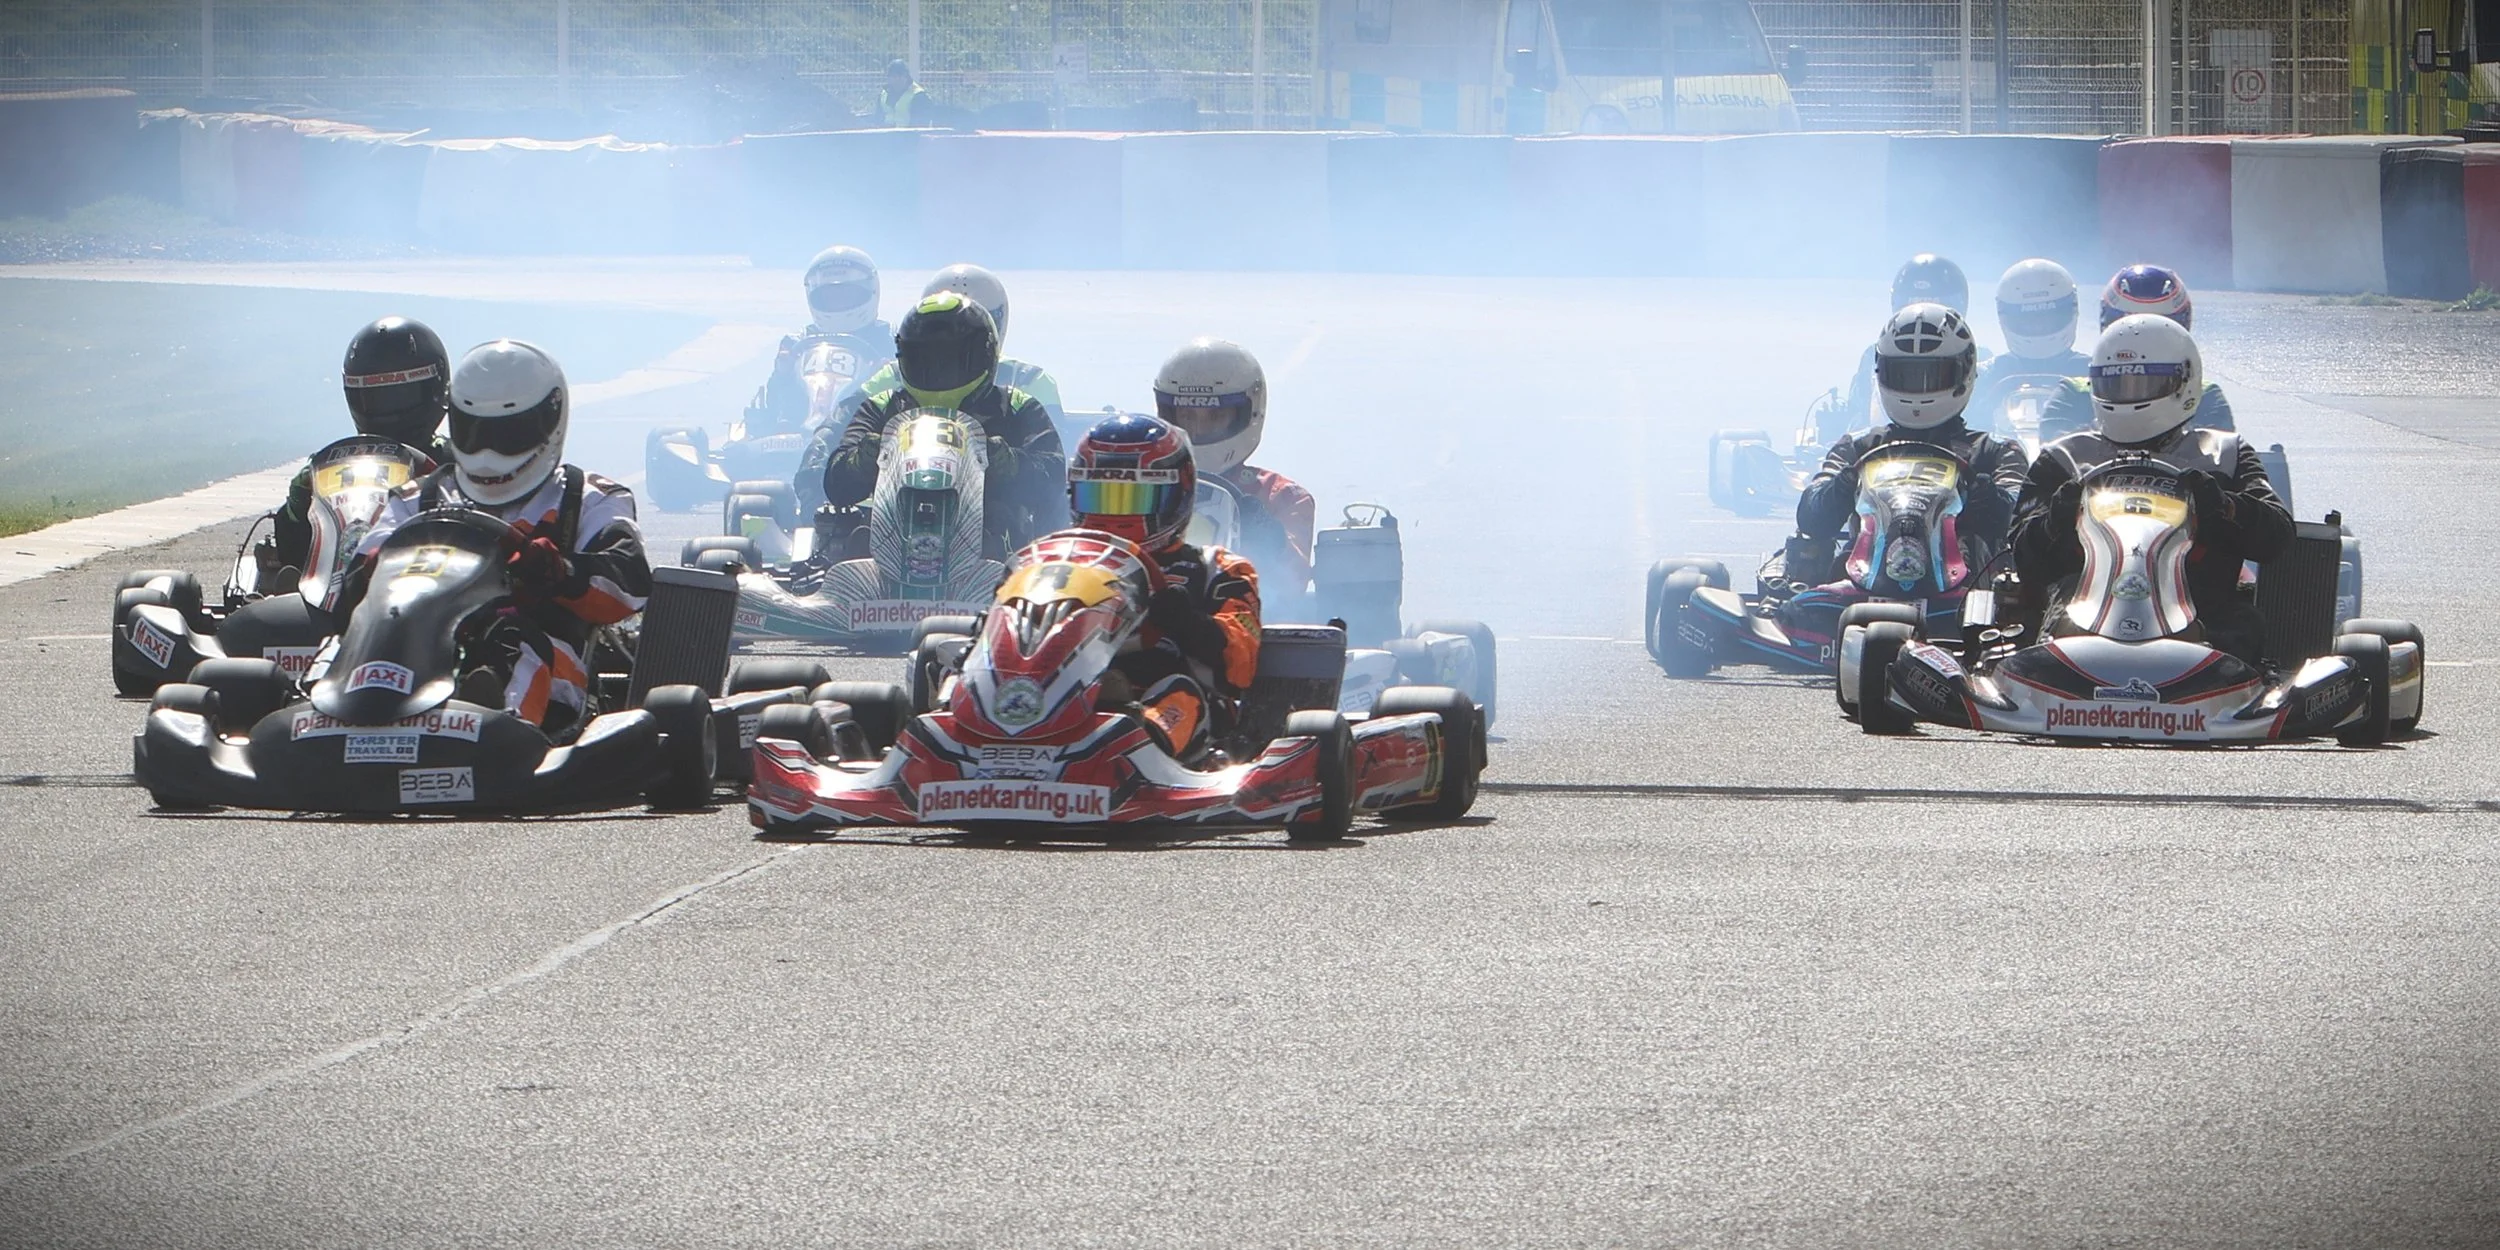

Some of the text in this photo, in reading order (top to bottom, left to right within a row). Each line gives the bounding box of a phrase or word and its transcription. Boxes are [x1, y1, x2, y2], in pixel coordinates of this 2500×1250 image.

[2237, 75, 2260, 91] 10
[803, 351, 856, 377] 43
[2102, 364, 2146, 377] NKRA
[1173, 396, 1220, 406] NKRA
[1087, 469, 1136, 481] NKRA
[2124, 497, 2153, 514] 6
[851, 601, 970, 625] planetkarting
[2046, 703, 2207, 736] planetkarting.uk
[347, 746, 394, 754] TRAVEL
[982, 748, 1051, 760] BEBA
[401, 772, 472, 791] BEBA
[921, 783, 1105, 819] planetkarting.uk
